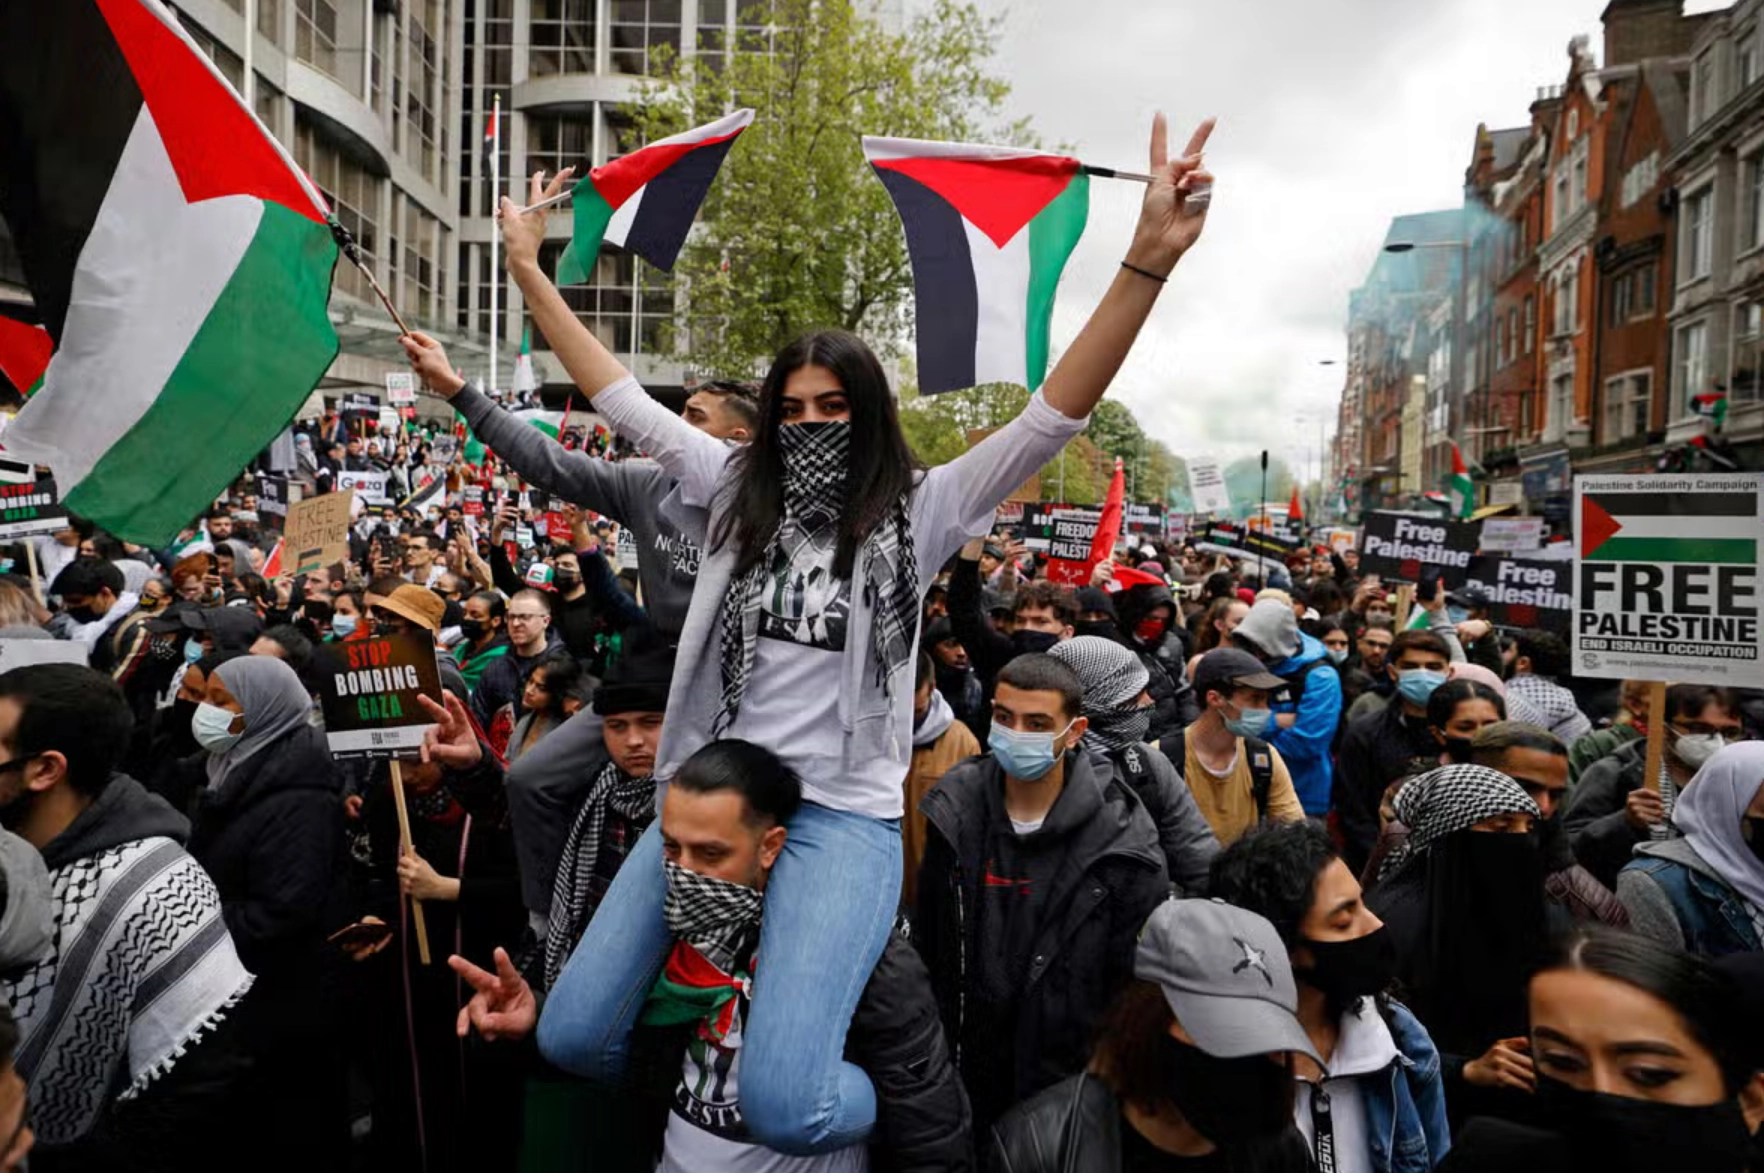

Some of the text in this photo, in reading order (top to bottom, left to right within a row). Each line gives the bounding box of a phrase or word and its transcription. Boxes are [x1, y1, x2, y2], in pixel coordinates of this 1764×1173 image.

[1582, 479, 1758, 491] Palestine Solidarity Campaign
[1055, 521, 1098, 539] FREEDO
[1395, 519, 1446, 543] Free
[1365, 536, 1470, 567] Palestine
[1498, 560, 1556, 585] Free
[1580, 563, 1758, 617] FREE
[1579, 612, 1757, 643] PALESTINE
[347, 641, 391, 668] STOP
[1581, 638, 1755, 658] END ISRAELI OCCUPATION
[334, 664, 419, 697] BOMBING
[357, 694, 404, 721] GAZA
